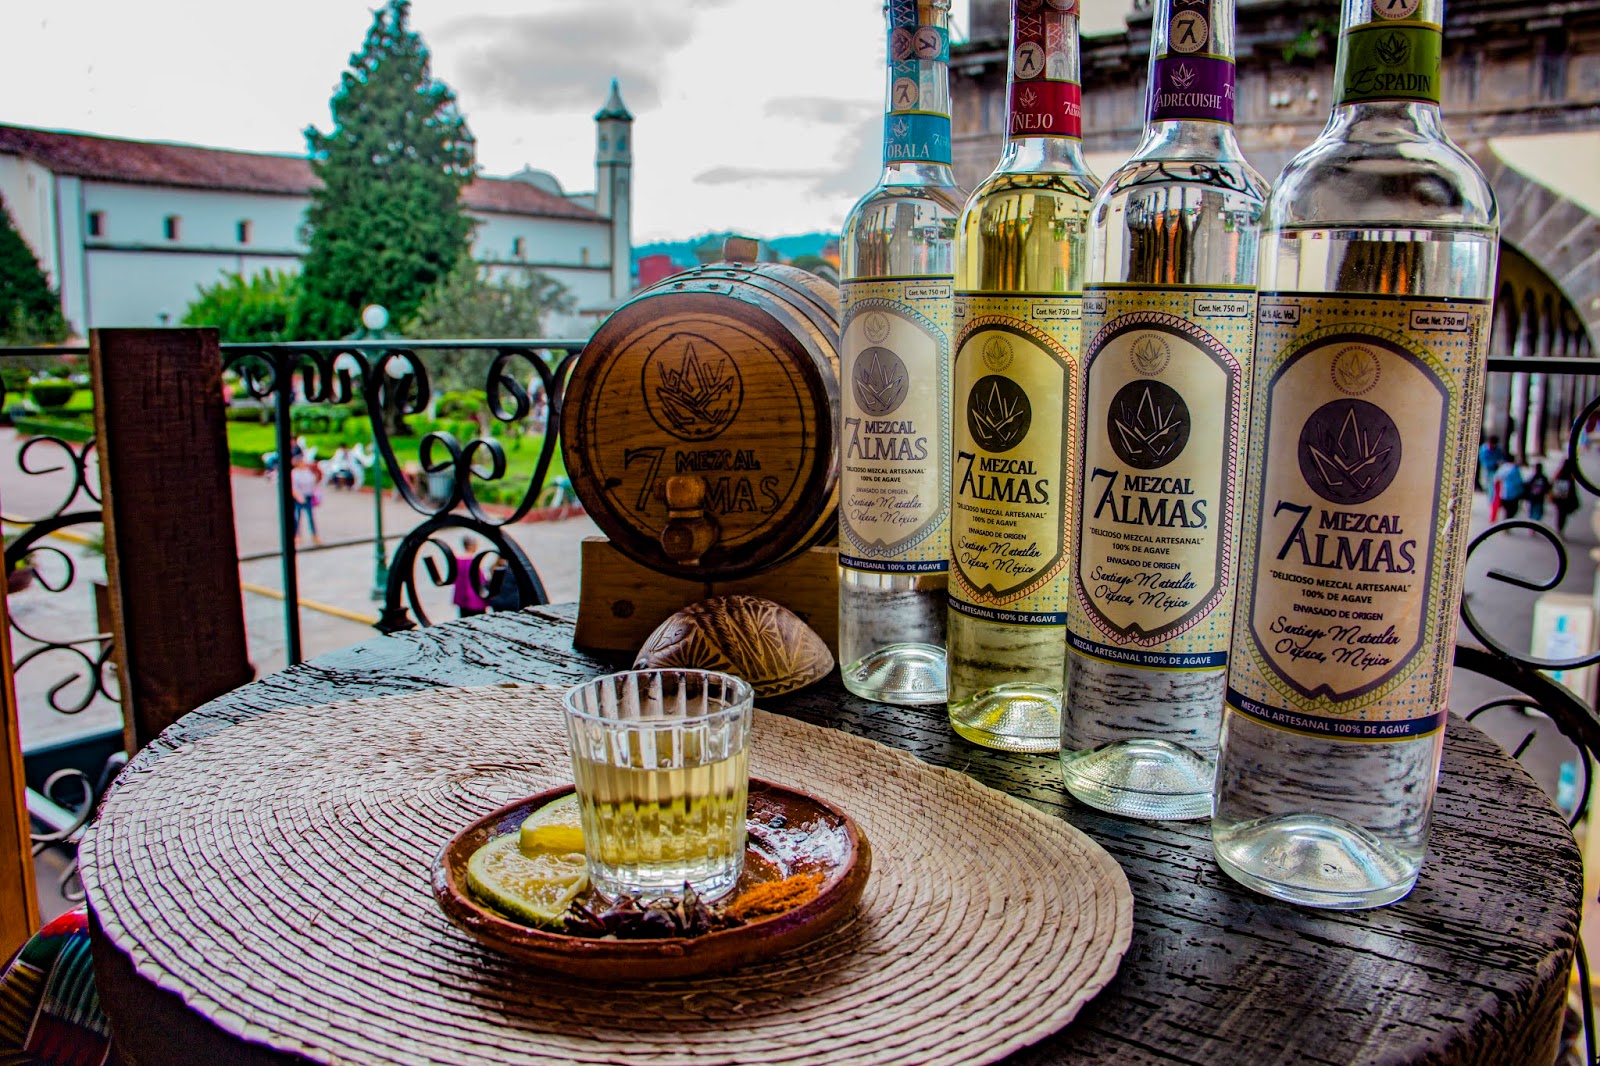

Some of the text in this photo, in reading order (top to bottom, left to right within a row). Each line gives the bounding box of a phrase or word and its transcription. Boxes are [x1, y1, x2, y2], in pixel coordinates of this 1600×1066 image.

[1345, 66, 1431, 95] ESPADIN
[886, 138, 930, 159] OBALÁ
[928, 288, 939, 296] 750
[1058, 308, 1070, 316] 750
[1070, 308, 1079, 316] ml
[1223, 304, 1236, 313] 750
[1236, 305, 1245, 313] ml
[1442, 316, 1456, 326] 750
[1456, 317, 1465, 326] ml
[865, 420, 916, 435] MEZCAL
[844, 416, 862, 459] 7
[675, 449, 761, 473] MEZCAL
[980, 457, 1038, 476] MEZCAL
[624, 447, 667, 512] 7
[867, 467, 889, 475] MEZCAL
[957, 450, 976, 495] 7
[1090, 466, 1119, 519] 7
[1124, 475, 1195, 496] MEZCAL
[847, 494, 876, 512] Santiago
[980, 507, 1004, 517] MEZCAL
[880, 511, 918, 527] México
[972, 515, 986, 524] 100%
[995, 519, 1018, 527] AGAVE
[1319, 509, 1403, 535] MEZCAL
[968, 527, 1027, 541] ENVASADO DE ORIGEN
[1123, 533, 1154, 544] MEZCAL
[1273, 500, 1313, 561] 7
[957, 536, 988, 561] Santiago
[1112, 543, 1170, 555] 100% DE AGAVE
[853, 560, 886, 571] ARTESANAL
[887, 563, 906, 571] 100%
[917, 563, 941, 571] AGAVE
[992, 559, 1036, 578] México
[1106, 555, 1181, 570] ENVASADO DE ORIGEN
[1091, 566, 1134, 594] Santiago
[1316, 578, 1353, 590] MEZCAL
[1094, 584, 1191, 613] Oaxaca, México
[1301, 588, 1373, 604] 100% DE AGAVE
[960, 602, 995, 619] ARTESANAL
[996, 610, 1017, 622] 100%
[1018, 614, 1029, 623] DE
[1030, 614, 1057, 624] AGAVE
[1293, 603, 1384, 621] ENVASADO DE ORIGEN
[1269, 615, 1327, 649] Santiago
[1073, 637, 1211, 665] MEZCAL ARTESANAL 100% DE AGAVE
[1275, 638, 1393, 671] Oaxaca, México
[1241, 699, 1410, 735] MEZCAL ARTESANAL 100% DE AGAVE
